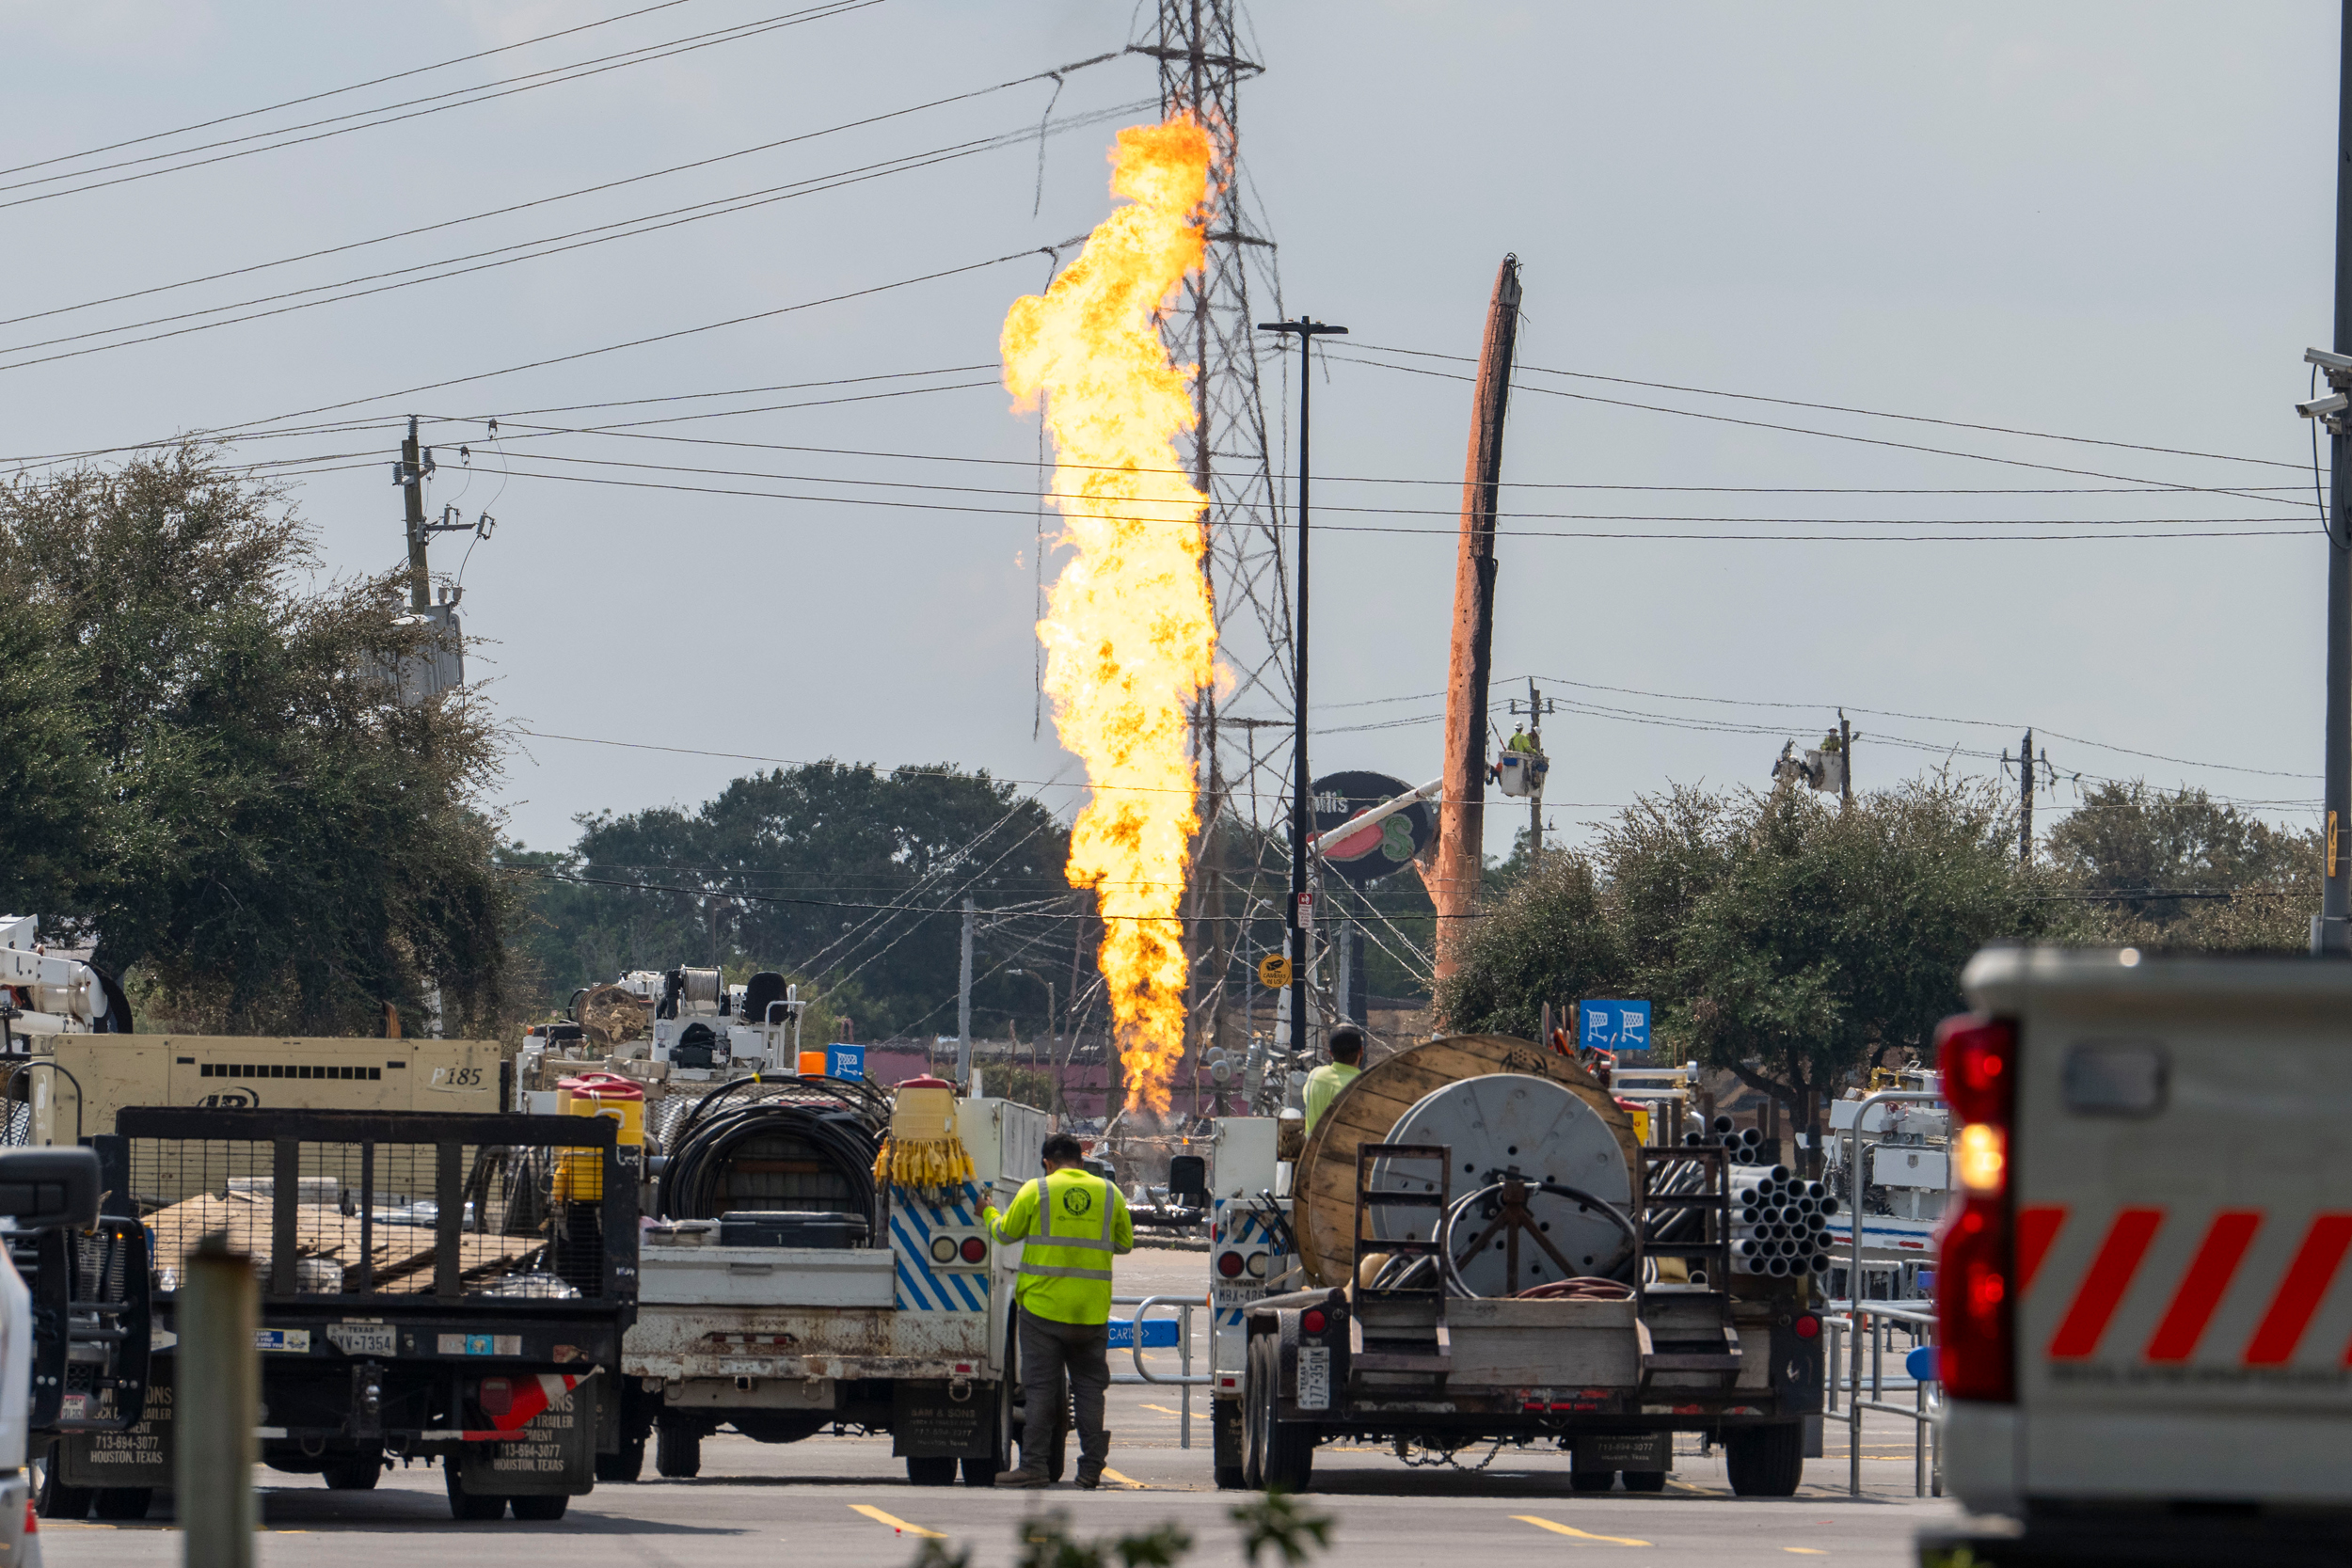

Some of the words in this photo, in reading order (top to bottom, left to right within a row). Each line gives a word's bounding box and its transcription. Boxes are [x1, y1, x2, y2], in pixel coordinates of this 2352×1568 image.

[535, 1414, 574, 1429] TRAILER
[96, 1435, 159, 1449] 713-694-3077
[136, 1450, 164, 1464] TEXAS
[537, 1459, 564, 1472] TEXAS
